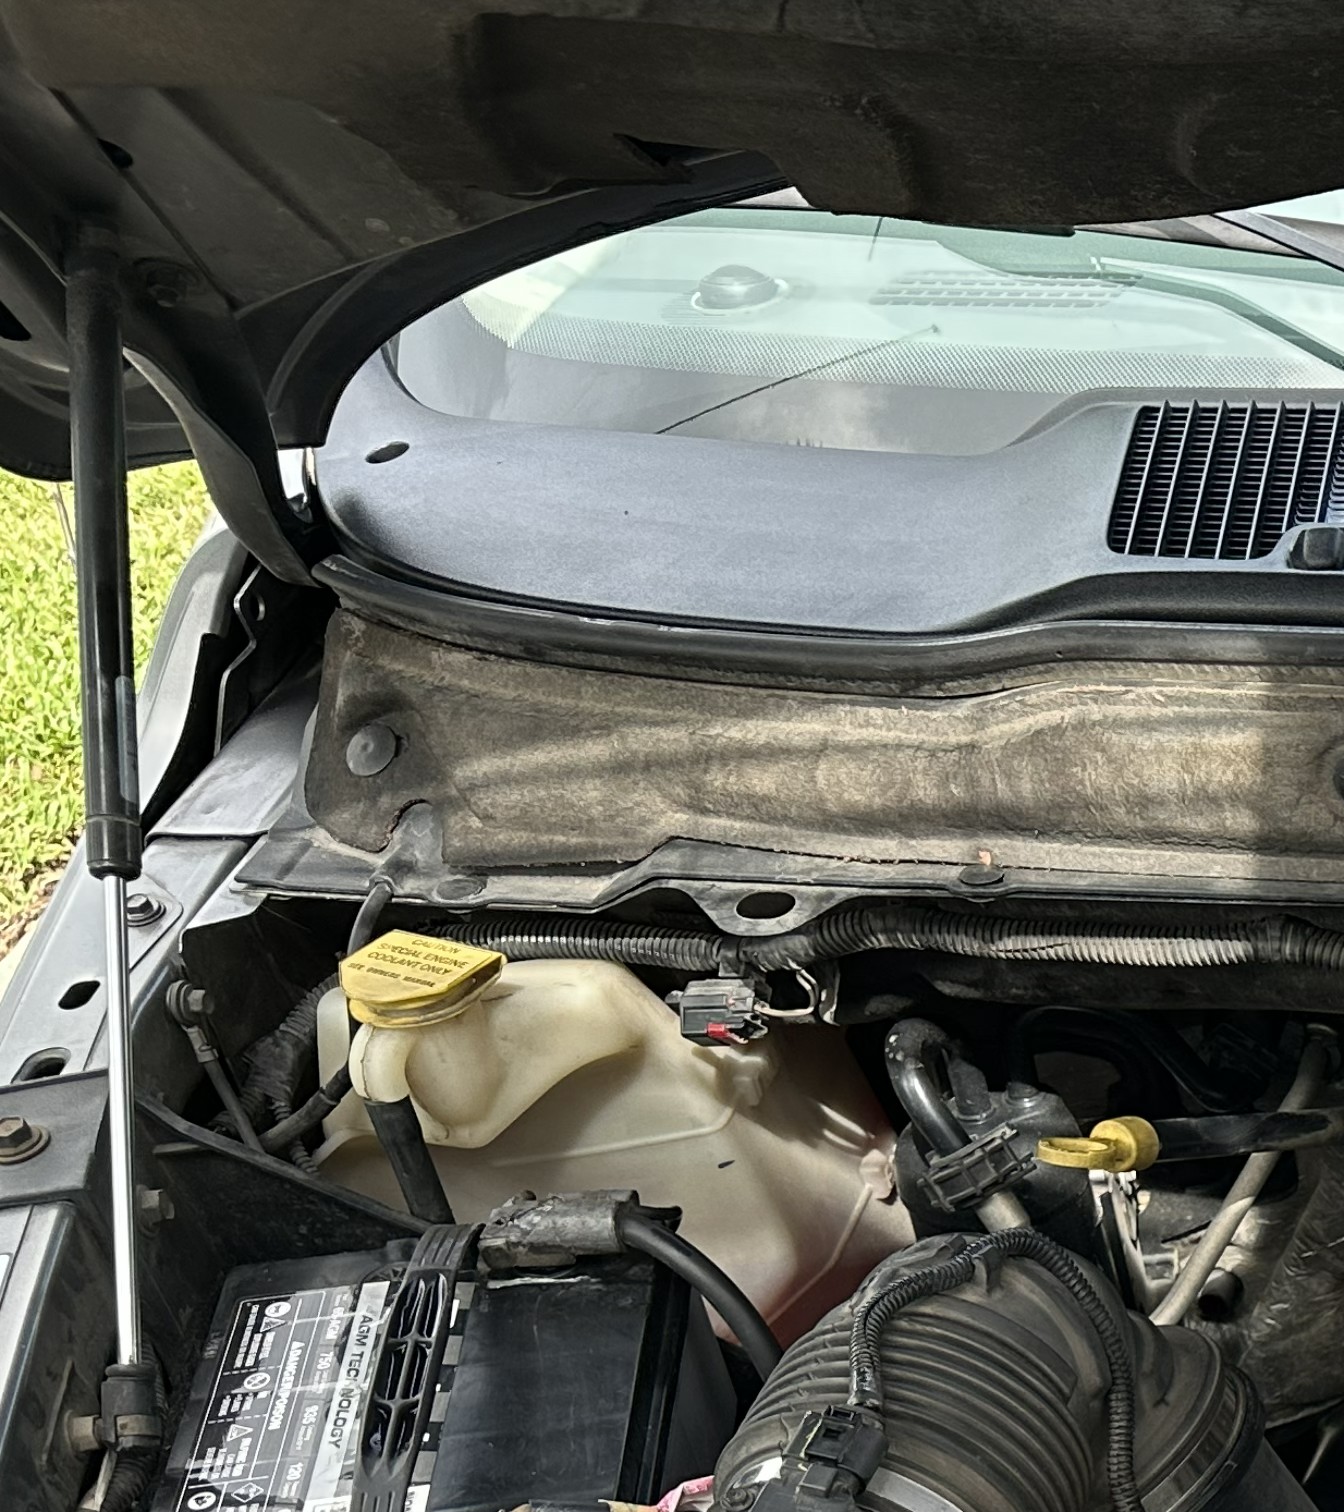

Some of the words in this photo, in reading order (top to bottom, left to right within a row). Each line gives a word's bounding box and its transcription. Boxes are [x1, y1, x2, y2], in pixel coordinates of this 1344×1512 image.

[368, 952, 422, 968] COOLANT
[420, 964, 452, 975] ONLY
[377, 943, 422, 958] SPECIAL
[423, 953, 469, 968] ENGINE
[353, 1313, 377, 1347] AGM
[315, 1351, 334, 1370] 750
